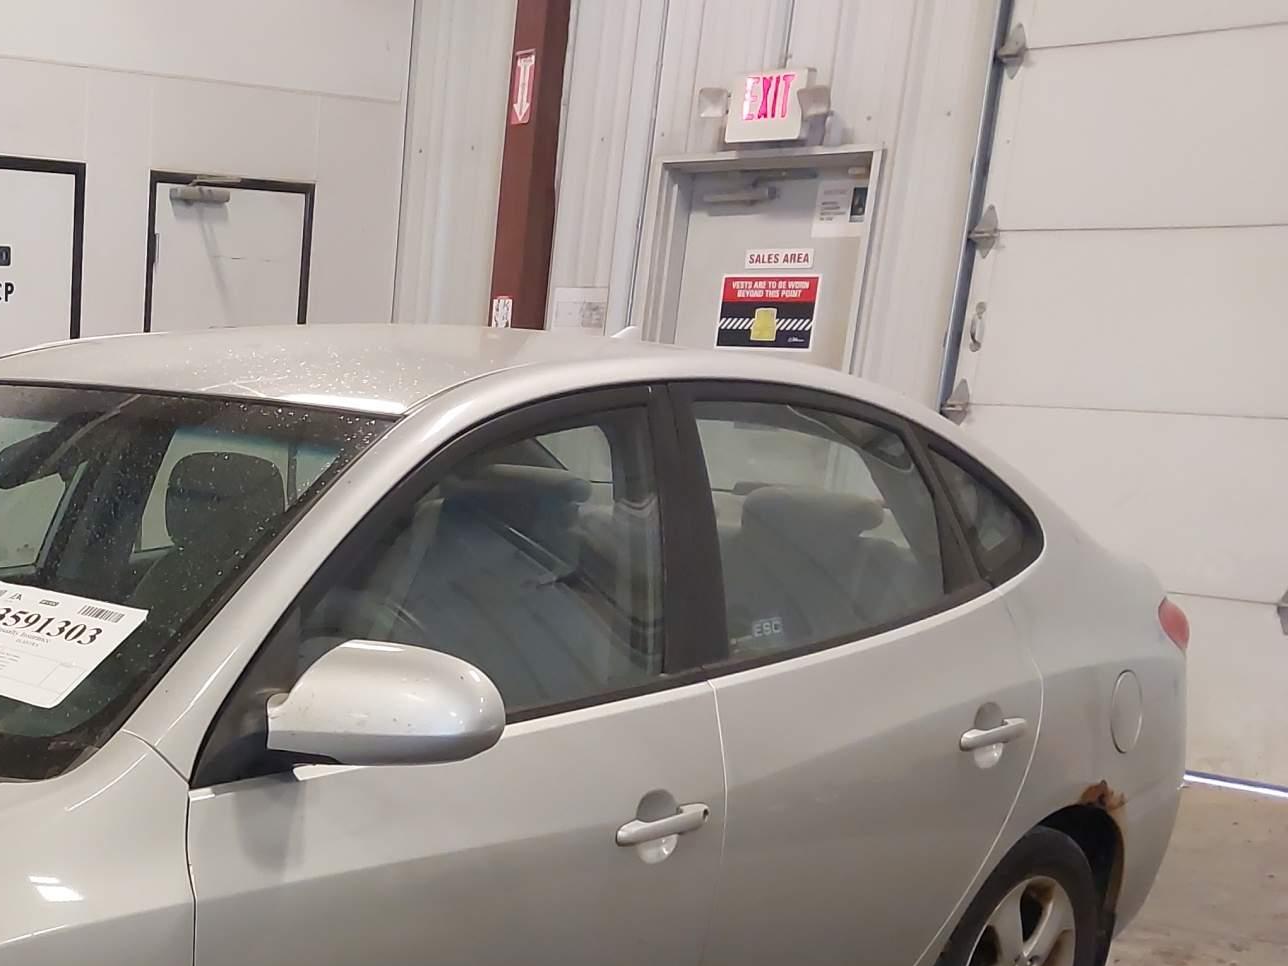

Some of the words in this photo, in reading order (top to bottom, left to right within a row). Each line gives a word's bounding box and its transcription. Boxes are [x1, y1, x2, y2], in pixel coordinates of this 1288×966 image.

[743, 75, 795, 120] EXIT
[749, 253, 780, 264] SALES
[783, 252, 809, 264] AREA
[732, 281, 752, 289] VESTS
[753, 281, 767, 289] ARE
[768, 281, 777, 289] TO
[778, 281, 787, 289] BE
[788, 281, 810, 289] WORN
[737, 289, 764, 298] BEYOND
[765, 289, 779, 298] THIS
[781, 289, 803, 298] POINT
